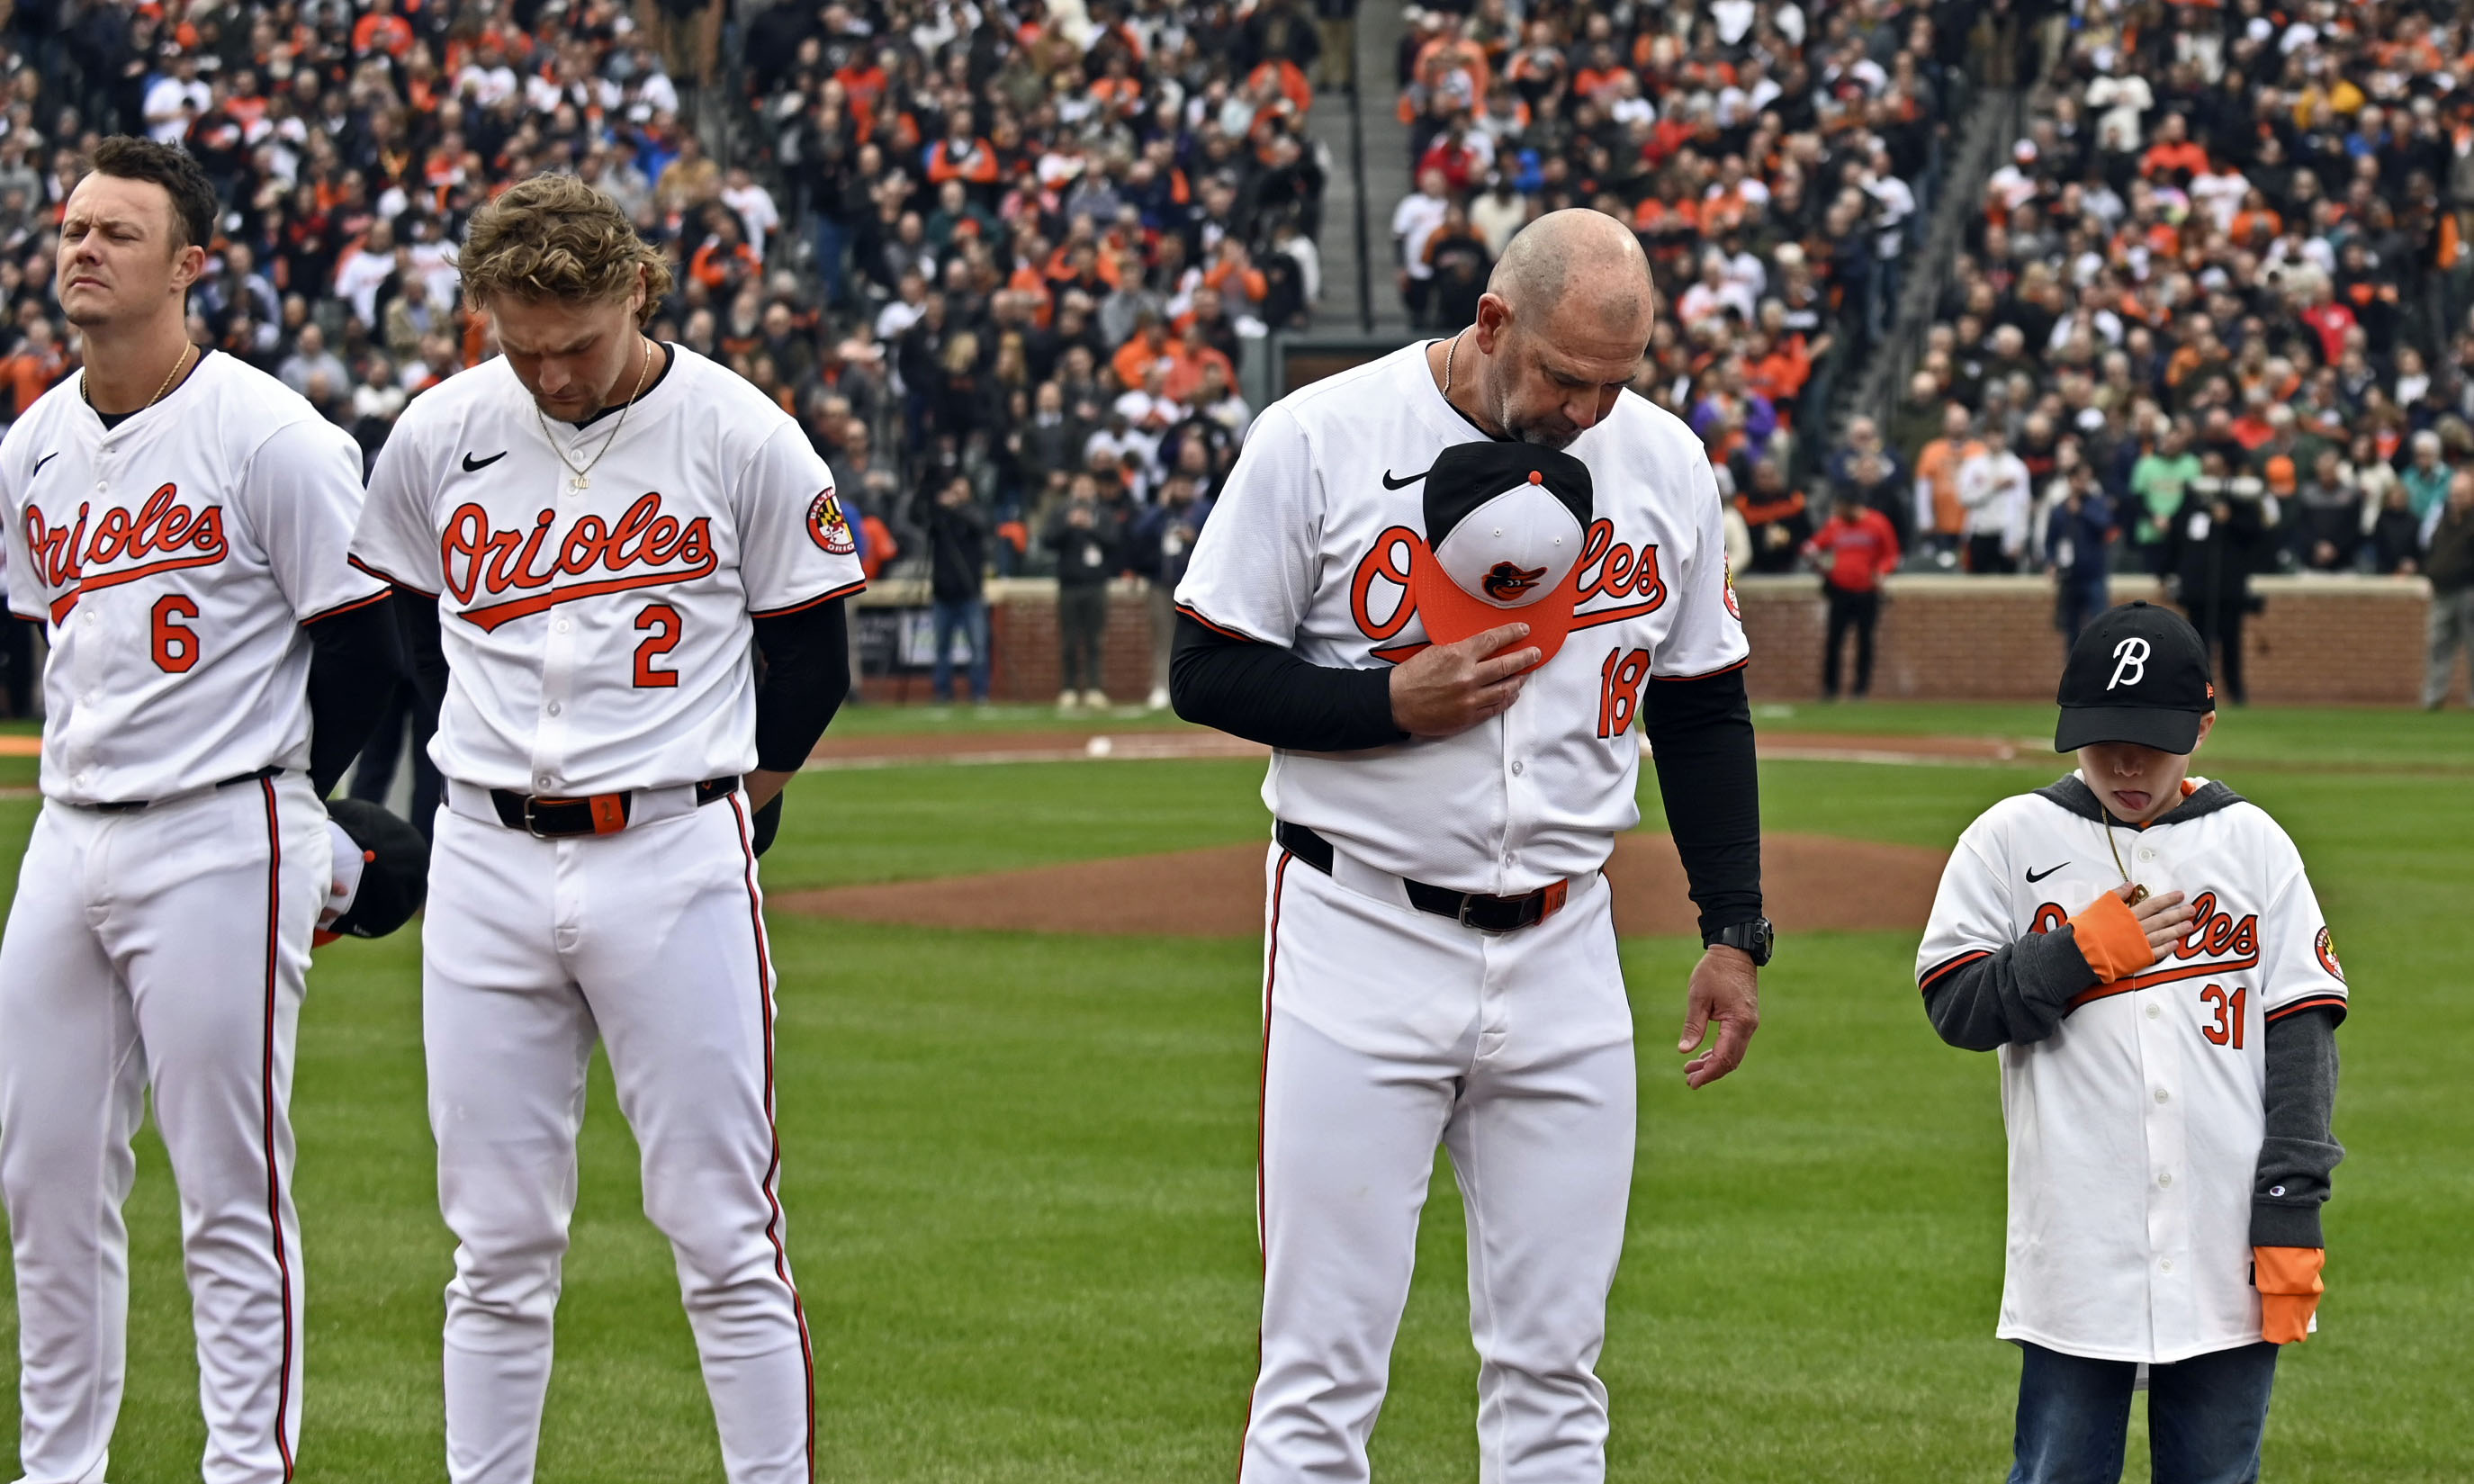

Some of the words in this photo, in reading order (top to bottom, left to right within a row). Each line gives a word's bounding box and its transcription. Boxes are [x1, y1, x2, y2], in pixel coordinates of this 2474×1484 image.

[26, 482, 229, 589] Orioles
[441, 491, 718, 606] Orioles
[1351, 517, 1667, 641] Oles
[151, 594, 200, 673] 6
[633, 604, 682, 688] 2
[2106, 637, 2151, 691] B
[1597, 646, 1651, 739] 18
[2200, 983, 2246, 1050] 31
